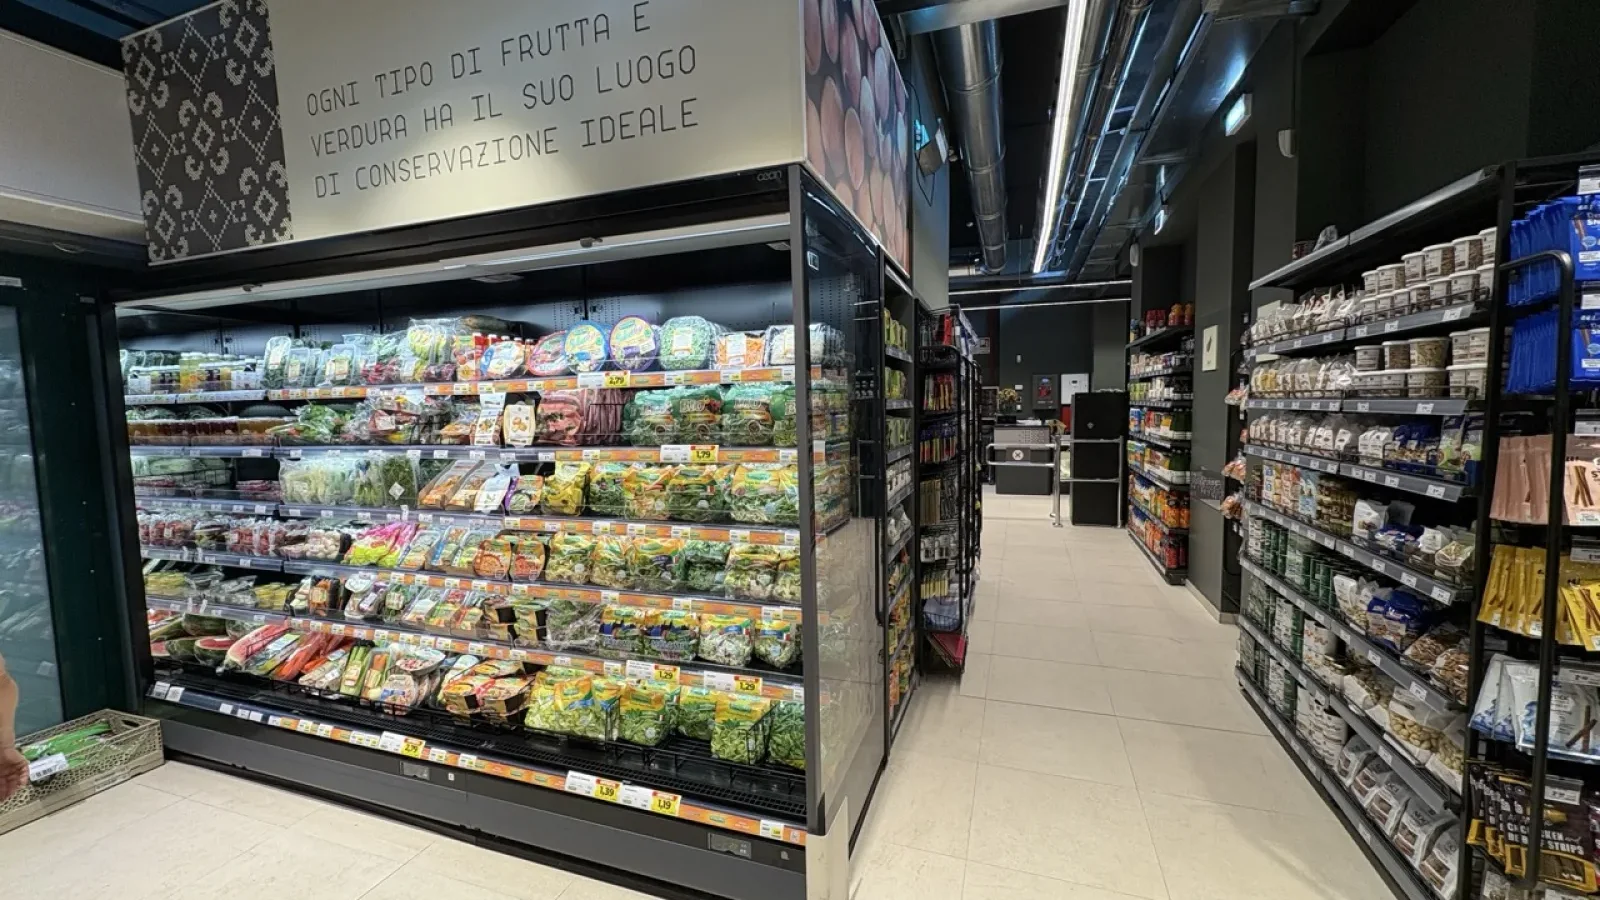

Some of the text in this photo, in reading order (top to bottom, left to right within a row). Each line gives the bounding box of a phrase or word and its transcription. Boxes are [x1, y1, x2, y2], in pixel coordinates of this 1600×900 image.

[306, 1, 651, 116] OGNI TIPO DI FRUTTA E
[310, 44, 696, 157] VERDURA HA IL SUO LUOGO
[314, 97, 698, 198] DI CONSERVAZIONE IDEALE
[1546, 840, 1585, 856] STRIPS
